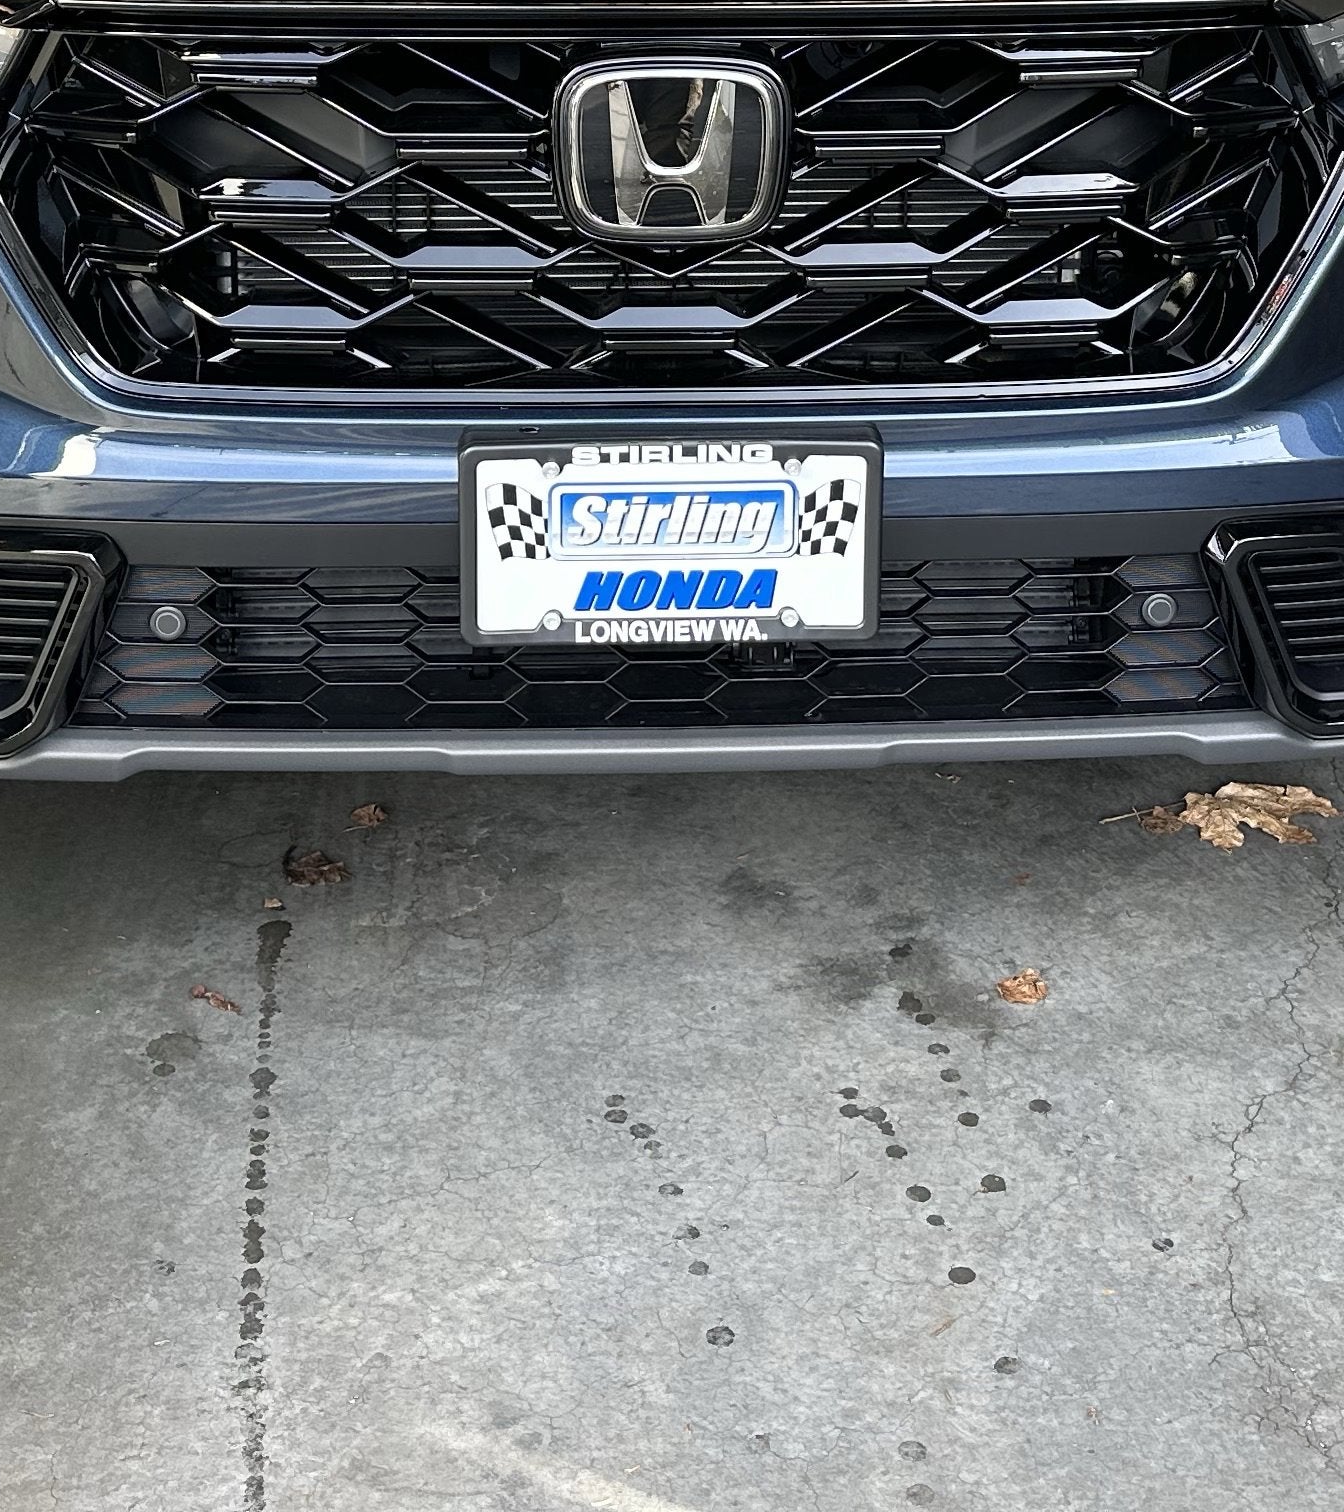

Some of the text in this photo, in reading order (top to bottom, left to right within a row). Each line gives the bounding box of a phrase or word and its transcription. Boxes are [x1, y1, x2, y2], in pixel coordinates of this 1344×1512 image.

[571, 443, 774, 466] STIRLING
[567, 494, 779, 554] Stirling
[574, 568, 778, 612] HONDA
[575, 619, 719, 644] LONGVIEW
